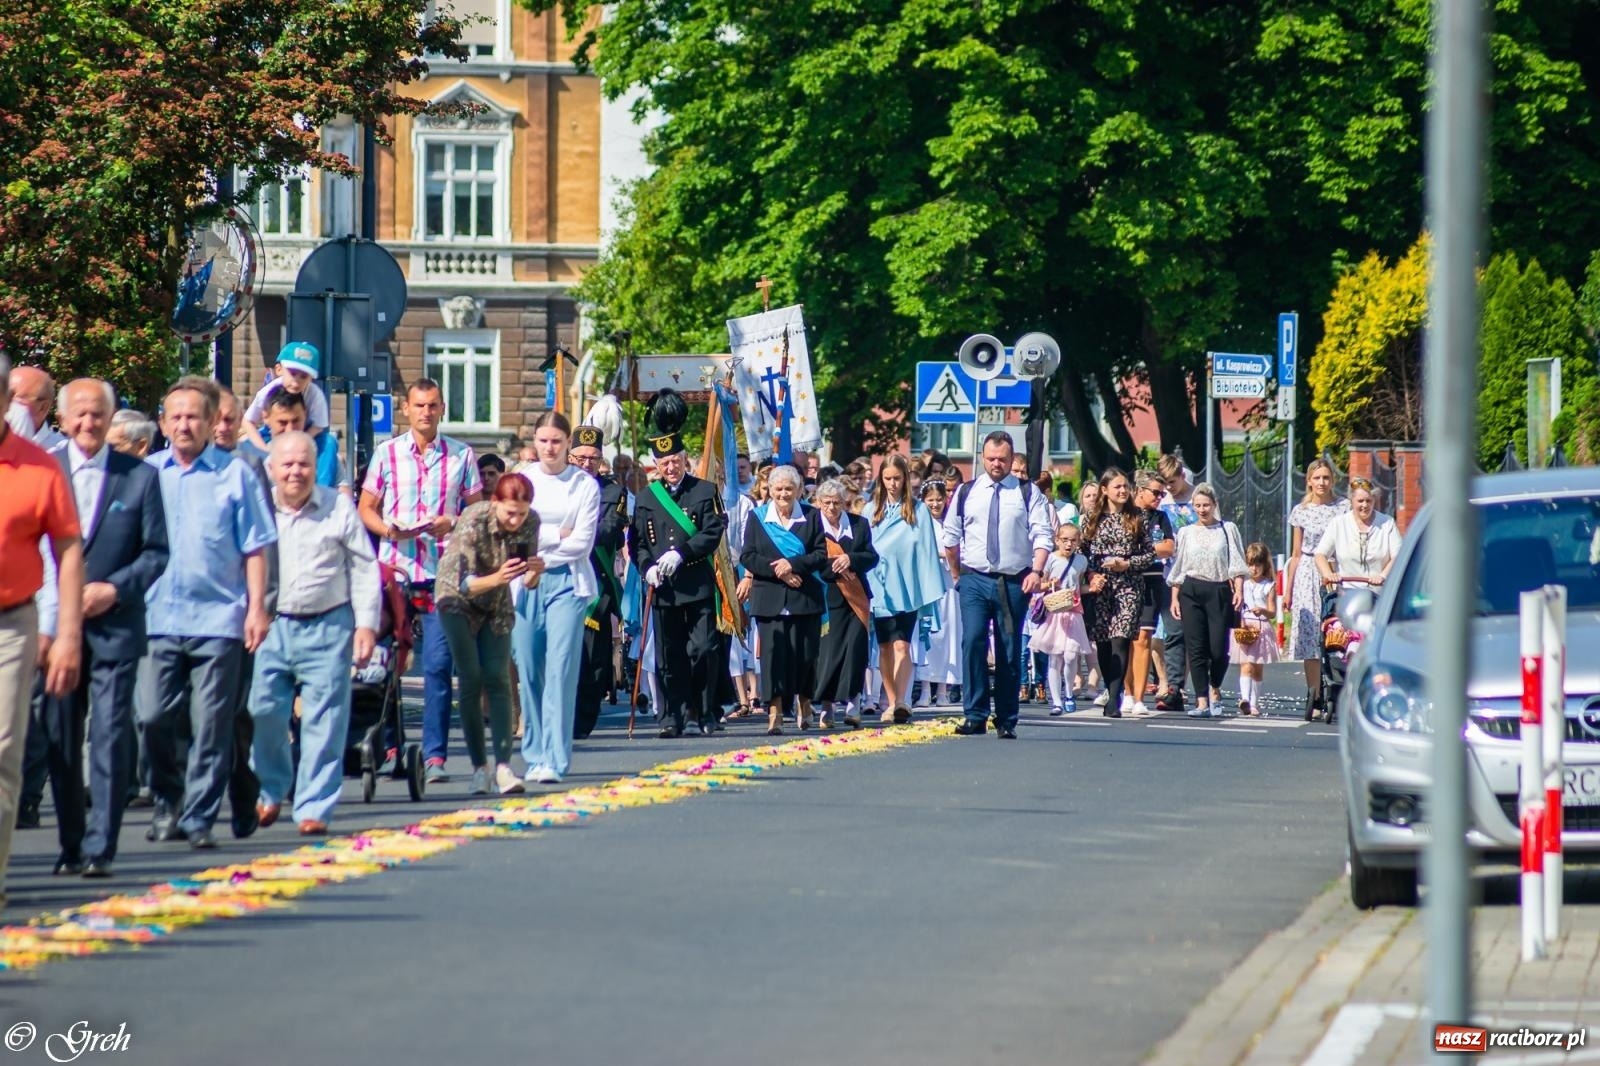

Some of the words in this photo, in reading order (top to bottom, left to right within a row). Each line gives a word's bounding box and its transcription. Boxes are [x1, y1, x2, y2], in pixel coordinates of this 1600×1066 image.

[1283, 321, 1293, 364] P
[1216, 380, 1257, 393] Biblioteka
[1562, 768, 1600, 794] RC
